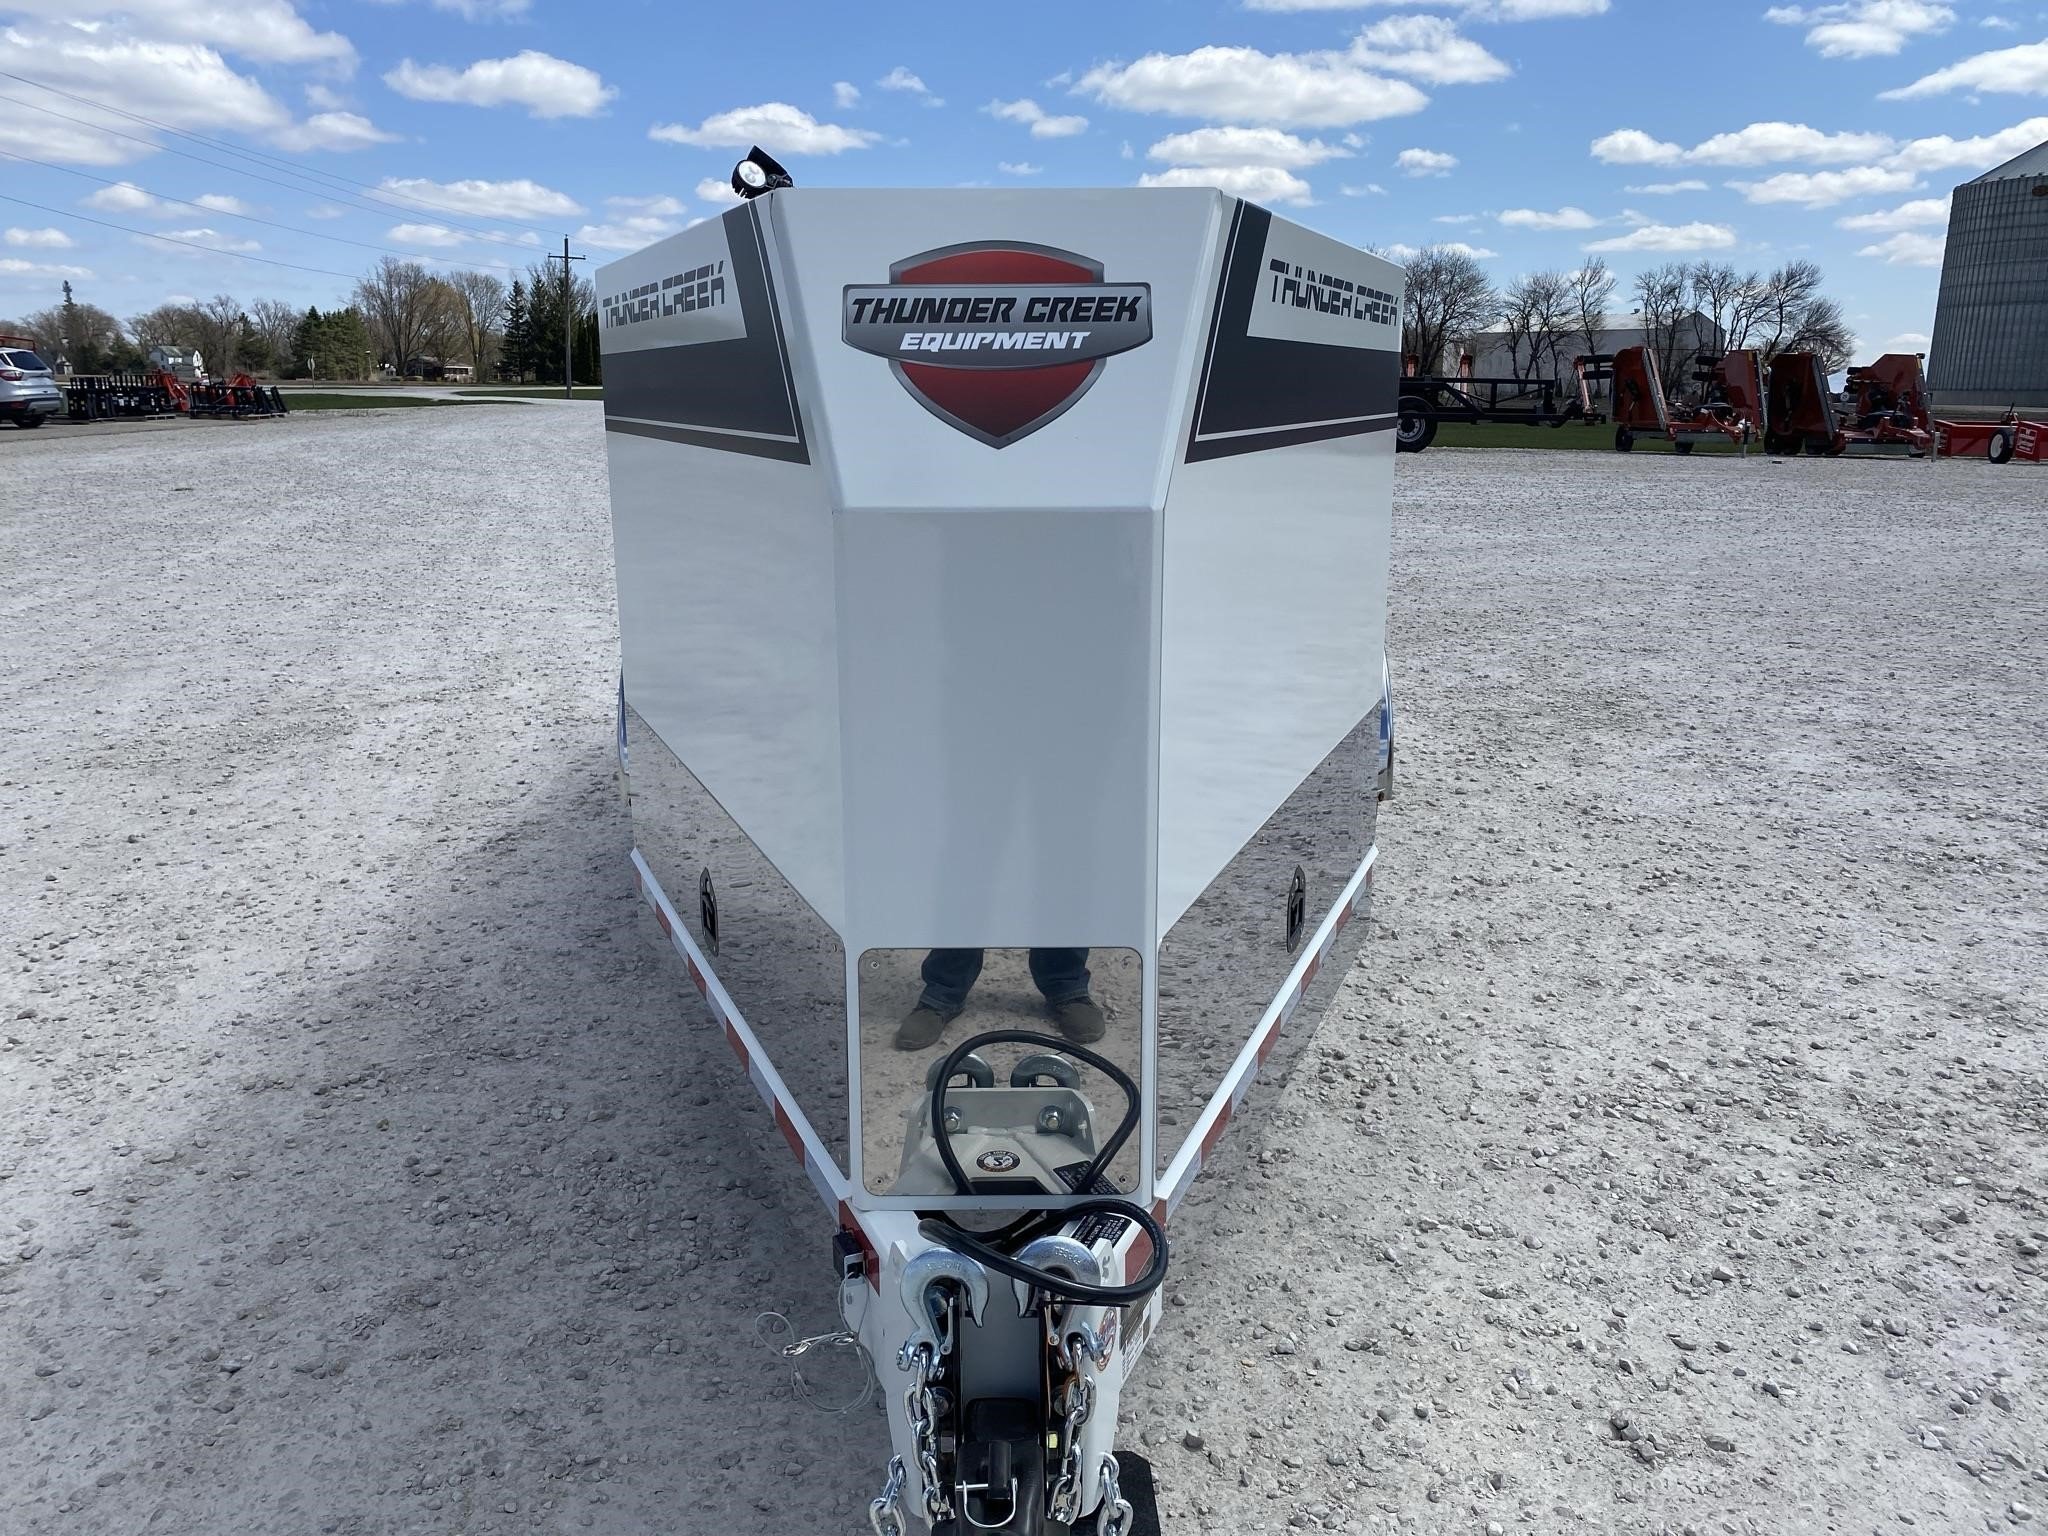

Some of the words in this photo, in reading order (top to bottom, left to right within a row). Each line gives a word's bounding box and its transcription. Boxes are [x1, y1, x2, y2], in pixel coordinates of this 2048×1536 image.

[602, 282, 660, 329] THUNDER
[662, 259, 725, 317] CREEK
[851, 296, 1018, 325] THUNDER
[1022, 295, 1143, 323] CREEK
[1269, 258, 1354, 318] THUNDER
[1354, 284, 1399, 327] CREEK
[899, 331, 1092, 353] EQUIPMENT
